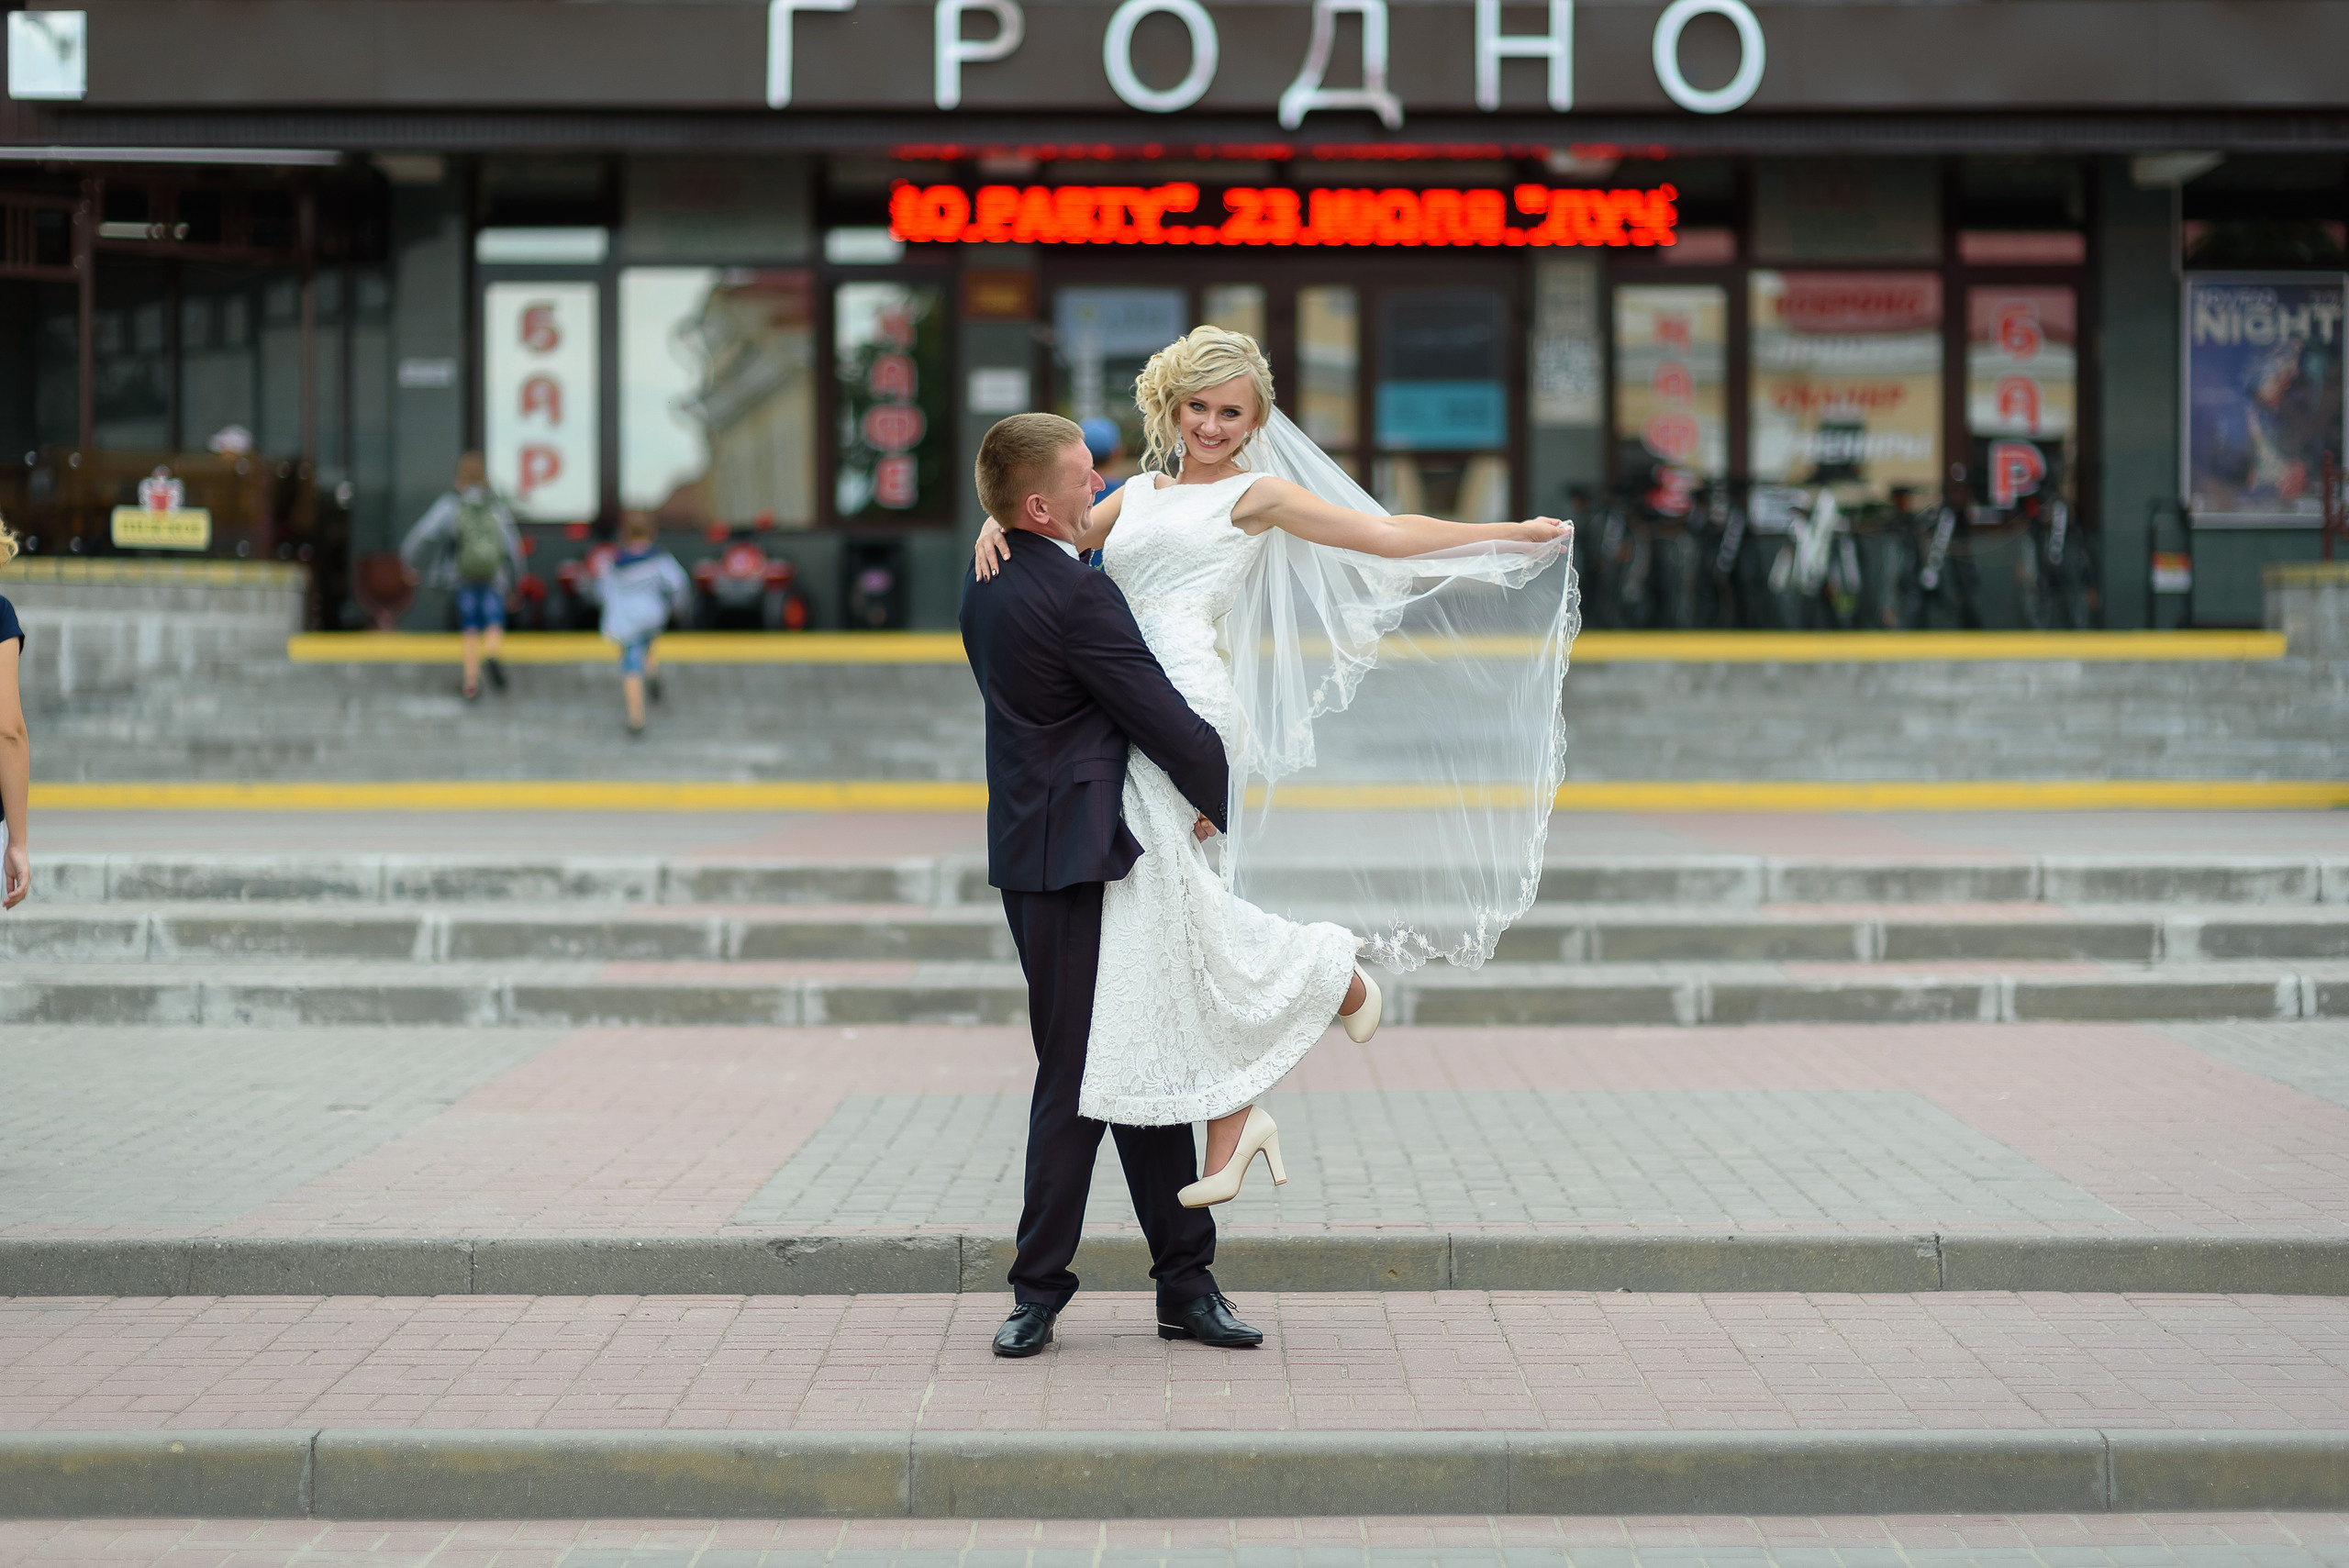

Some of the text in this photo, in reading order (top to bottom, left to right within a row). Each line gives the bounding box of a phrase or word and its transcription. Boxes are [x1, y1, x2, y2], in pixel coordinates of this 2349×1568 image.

[766, 0, 1767, 130] ГРОДНО
[518, 298, 563, 503] БАР
[1988, 300, 2047, 510] БАР
[2193, 302, 2343, 347] NIGHT
